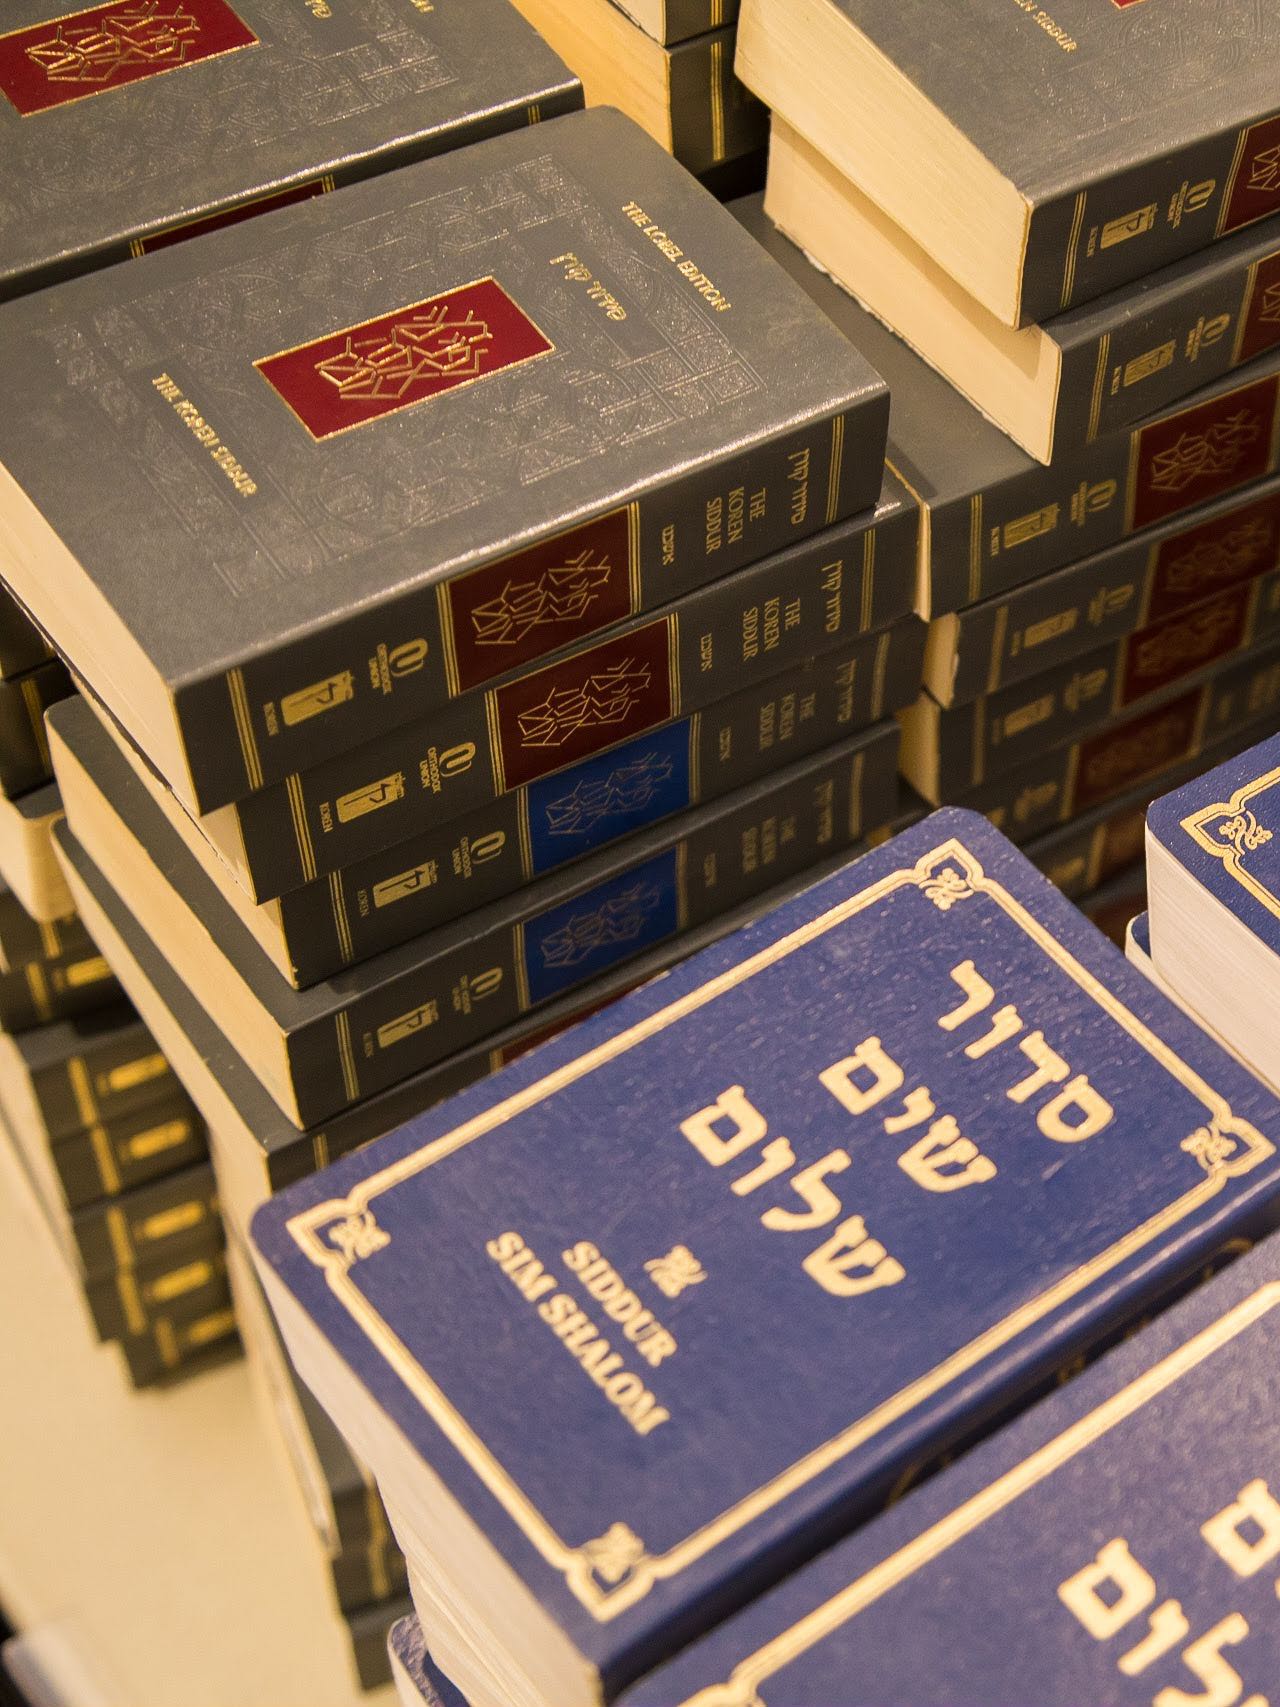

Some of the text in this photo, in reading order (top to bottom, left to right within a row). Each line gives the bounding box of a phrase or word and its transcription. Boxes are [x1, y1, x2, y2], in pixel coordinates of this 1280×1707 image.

[1032, 10, 1077, 53] SIDDUR
[621, 200, 732, 312] THE LOBEL EDITION
[151, 372, 257, 498] THE KOREN SIDDUR
[727, 486, 745, 545] KOREN
[749, 487, 767, 523] THE
[786, 447, 810, 525] סידור קורן
[705, 496, 723, 556] SIDDUR
[763, 596, 781, 652] KOREN
[785, 597, 801, 631] THE
[820, 559, 844, 633] סידור קורן
[742, 606, 759, 662] SIDDUR
[419, 759, 431, 789] UNION
[427, 746, 442, 795] ORTHODOX
[318, 801, 334, 833] KOREN
[938, 960, 1113, 1142] סדור
[819, 1036, 996, 1192] שים
[679, 1085, 905, 1296] שלום
[487, 1233, 669, 1434] SIM SHALOM
[563, 1241, 677, 1366] SIDDUR
[1056, 1536, 1271, 1707] לום
